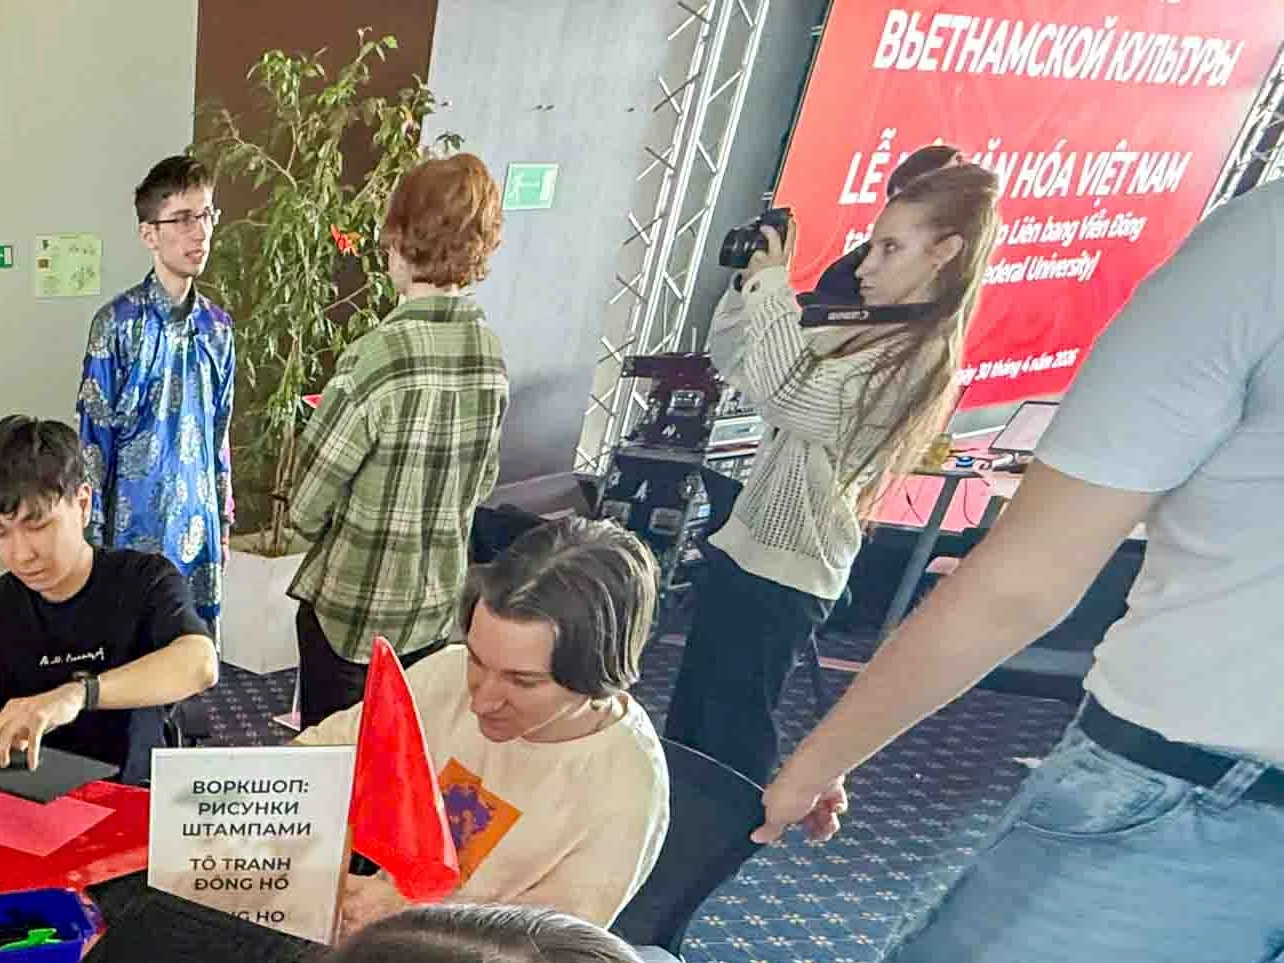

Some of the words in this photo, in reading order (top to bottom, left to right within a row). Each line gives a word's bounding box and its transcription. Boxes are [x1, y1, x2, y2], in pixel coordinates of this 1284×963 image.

[873, 8, 1118, 80] ВЬЕТНАМСКОЙ
[1105, 31, 1245, 87] КУЛЬТУРЫ
[838, 127, 897, 205] LỄ
[1011, 138, 1076, 199] HÓA
[1076, 138, 1137, 207] VIỆT
[1127, 151, 1190, 193] NAM
[1040, 216, 1080, 247] bang
[981, 257, 1031, 285] ederal
[192, 779, 309, 794] ВОРКШОП:
[198, 801, 299, 815] РИСУНКИ
[182, 822, 311, 836] ШТАМПАМИ
[222, 857, 291, 871] TRANH
